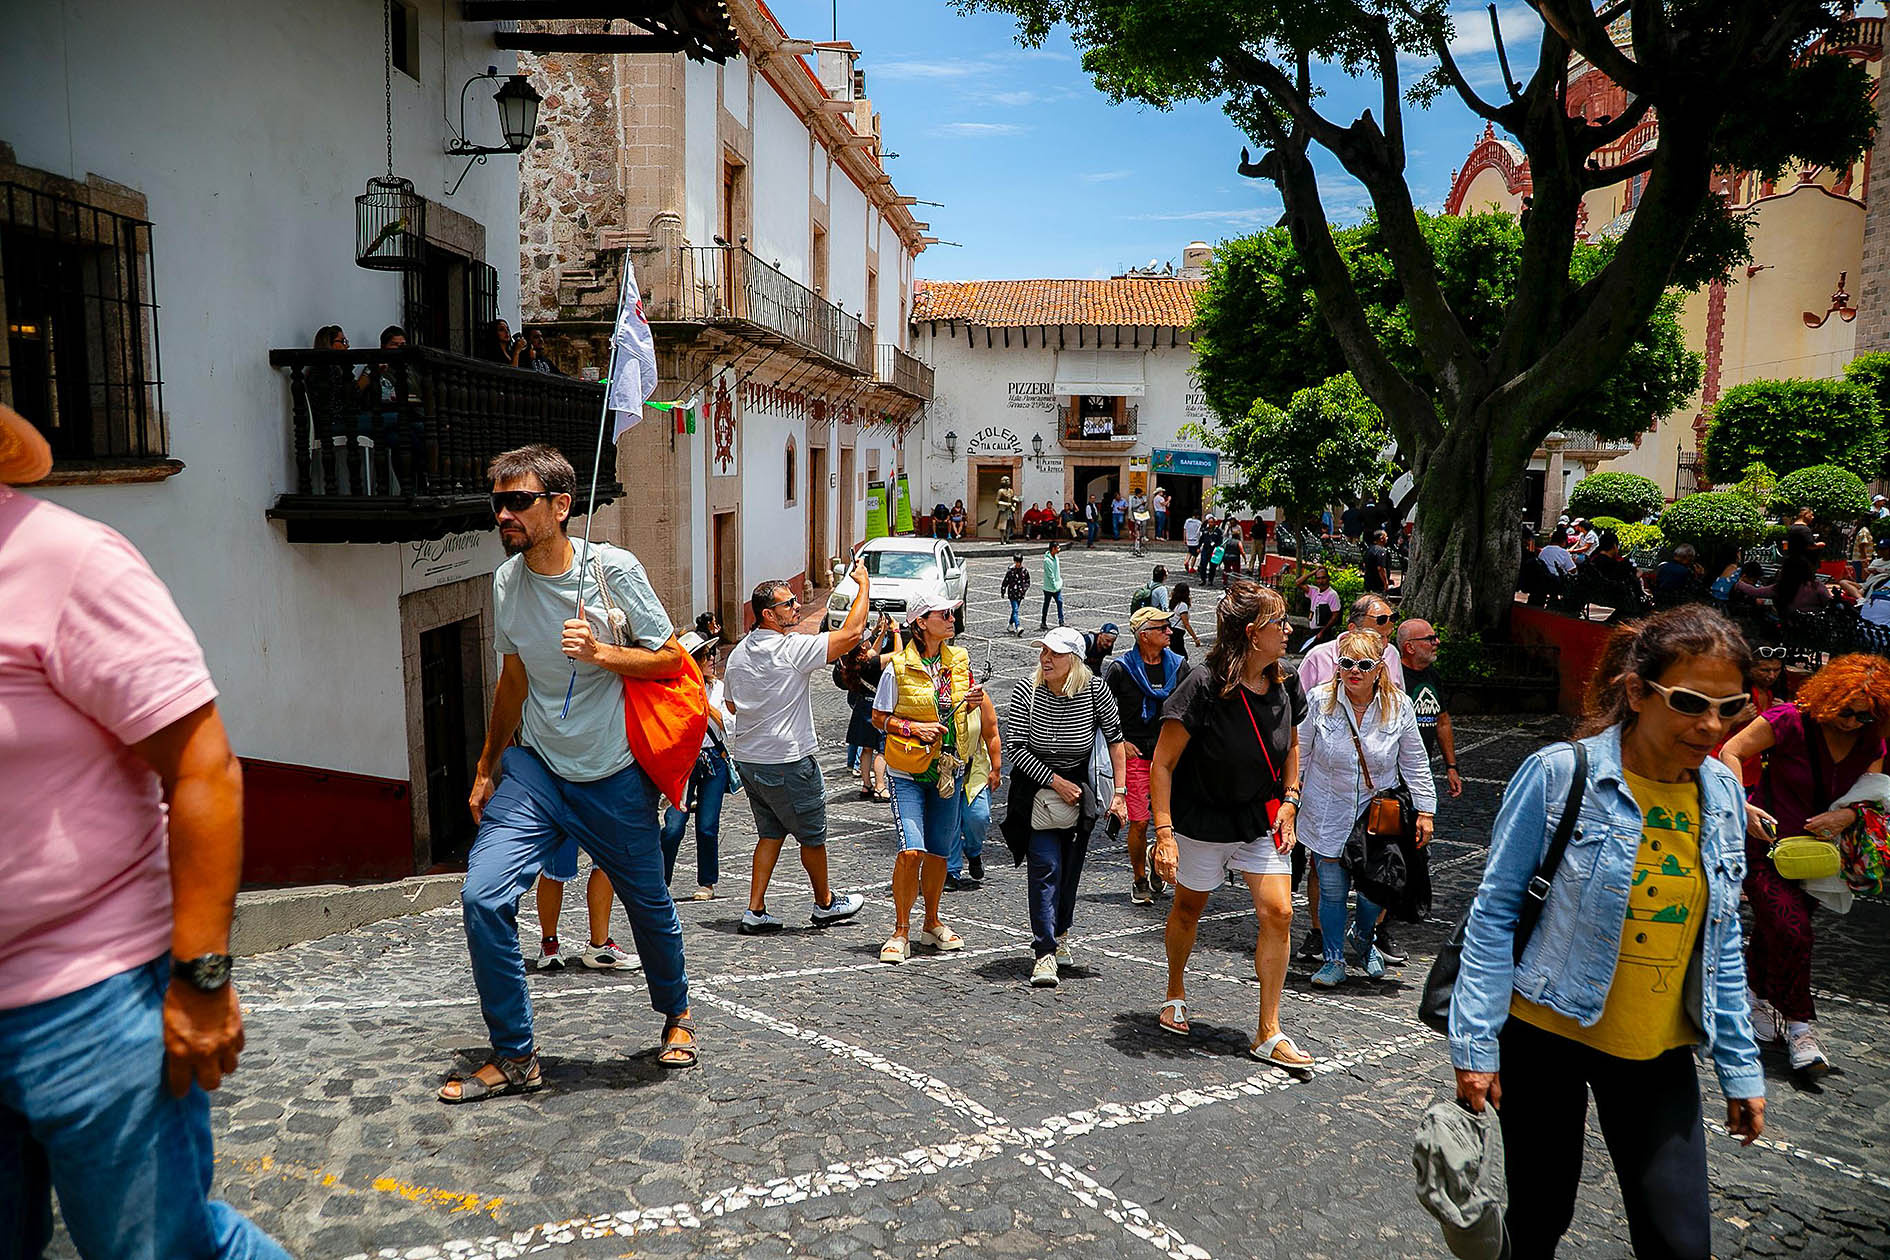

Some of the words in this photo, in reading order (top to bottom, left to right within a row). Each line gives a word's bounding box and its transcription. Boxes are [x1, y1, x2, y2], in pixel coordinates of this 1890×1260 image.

[1008, 382, 1055, 395] PIZZERIA
[966, 426, 1023, 455] POZOLERIA
[980, 442, 991, 451] TIA
[992, 442, 1012, 451] CALLA
[1180, 459, 1212, 467] SANITARIOS
